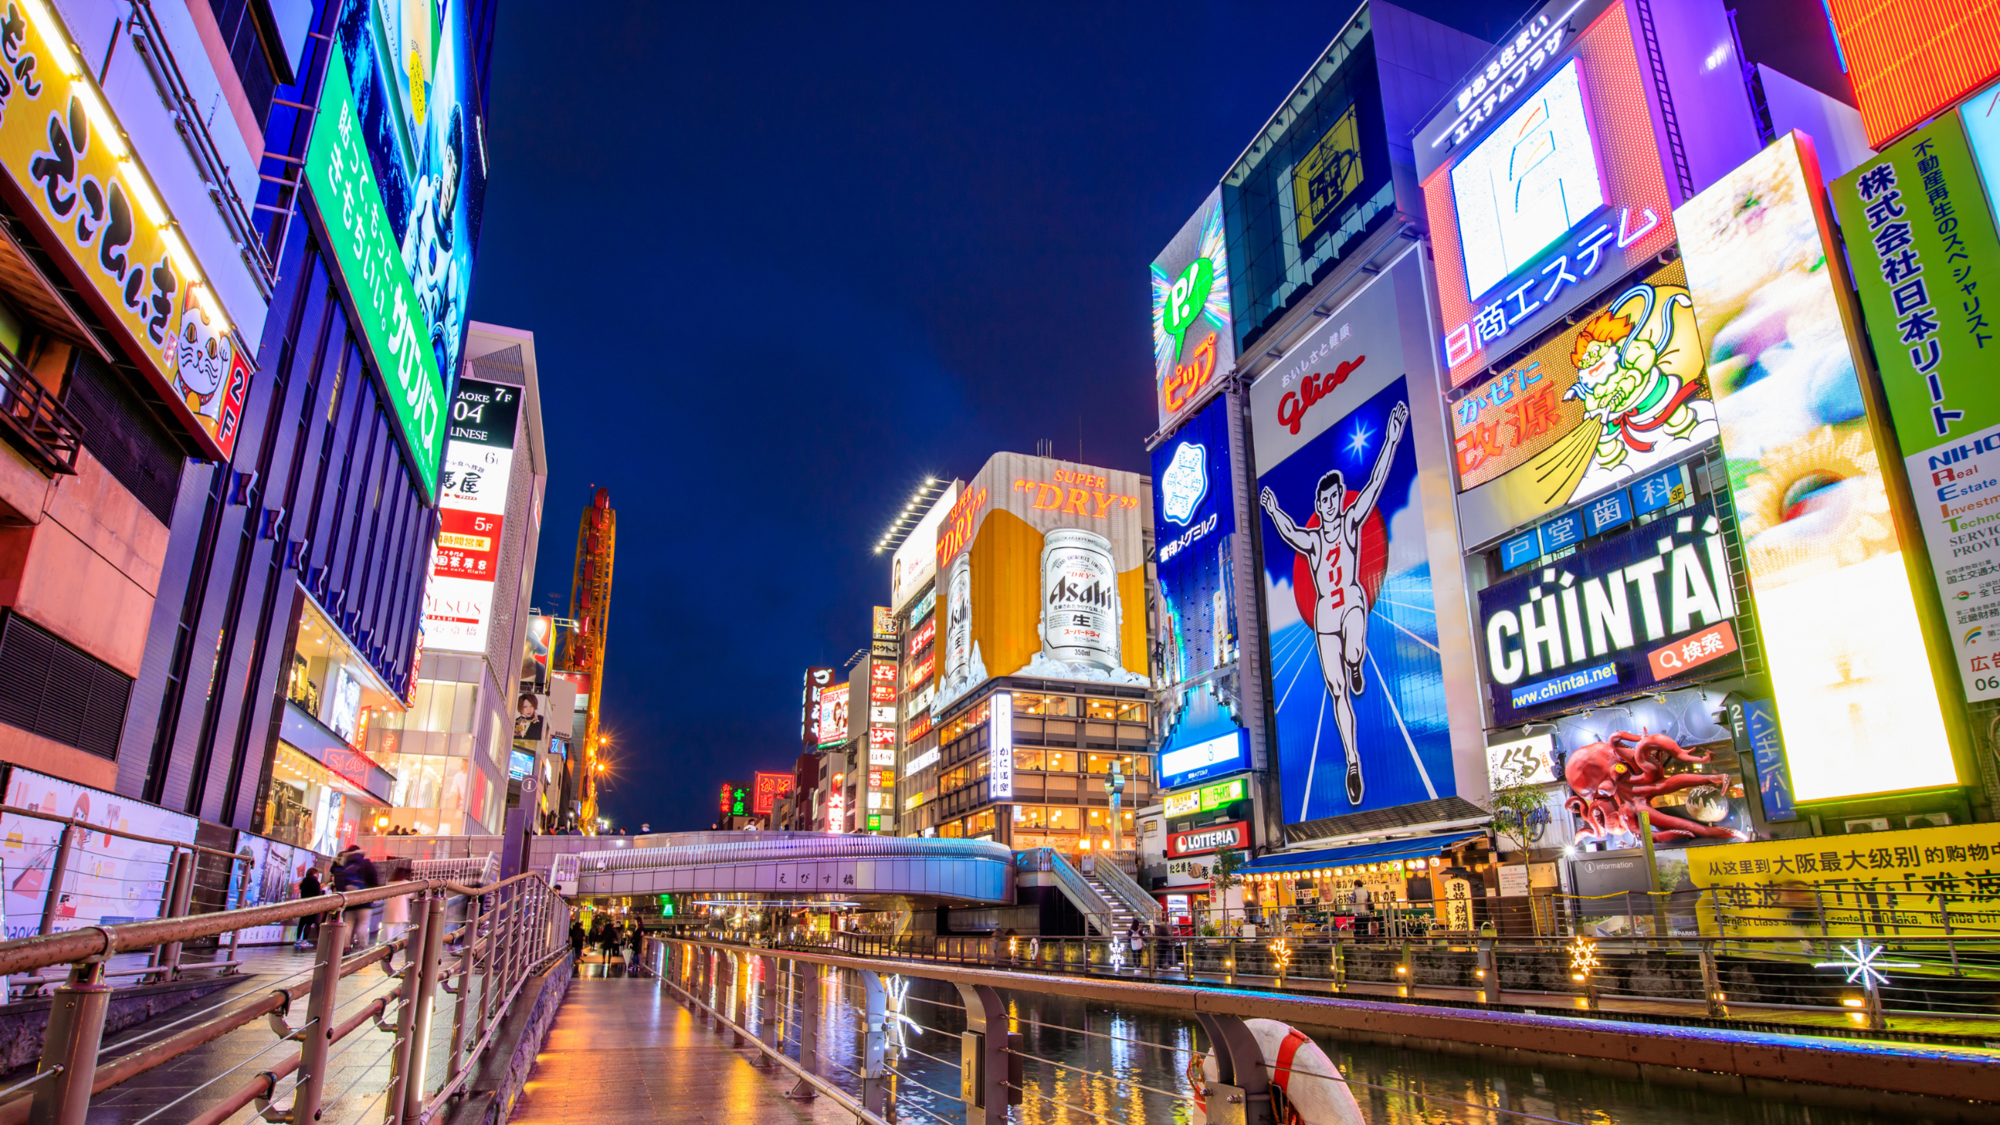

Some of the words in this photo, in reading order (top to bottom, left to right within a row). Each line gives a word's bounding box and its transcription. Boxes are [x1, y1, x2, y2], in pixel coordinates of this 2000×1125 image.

[1912, 137, 1993, 349] 不動産再生のスペシャリスト
[1443, 207, 1659, 368] 日商エステム
[1858, 162, 1964, 436] 株式会社日本リート
[1281, 322, 1353, 388] おいしさと健康
[387, 282, 439, 469] サロンパス
[1163, 332, 1218, 413] ピップ
[494, 388, 513, 402] 7F
[1458, 361, 1543, 426] かぜに
[1454, 380, 1560, 475] 改源
[1054, 469, 1107, 489] SUPER
[1932, 464, 1978, 487] Real
[1937, 478, 1998, 502] Estate
[949, 485, 974, 522] SUPER
[1508, 473, 1673, 564] 戸堂歯科
[1670, 487, 1683, 502] 3F
[474, 517, 493, 531] 5F
[1160, 513, 1217, 563] 雪印メグミルク
[1325, 541, 1346, 610] グリコ
[1946, 563, 2000, 585] 国土交通大
[1049, 575, 1112, 610] Asahi
[1486, 515, 1740, 685] CHINTAI
[1064, 629, 1101, 638] スーパードライ
[1072, 614, 1091, 627] 生
[1682, 632, 1724, 663] 検索
[1975, 675, 2000, 691] 06
[1731, 704, 1744, 738] 2F
[1188, 829, 1234, 849] LOTTERIA
[779, 872, 854, 886] えびす橋
[1596, 861, 1634, 871] information
